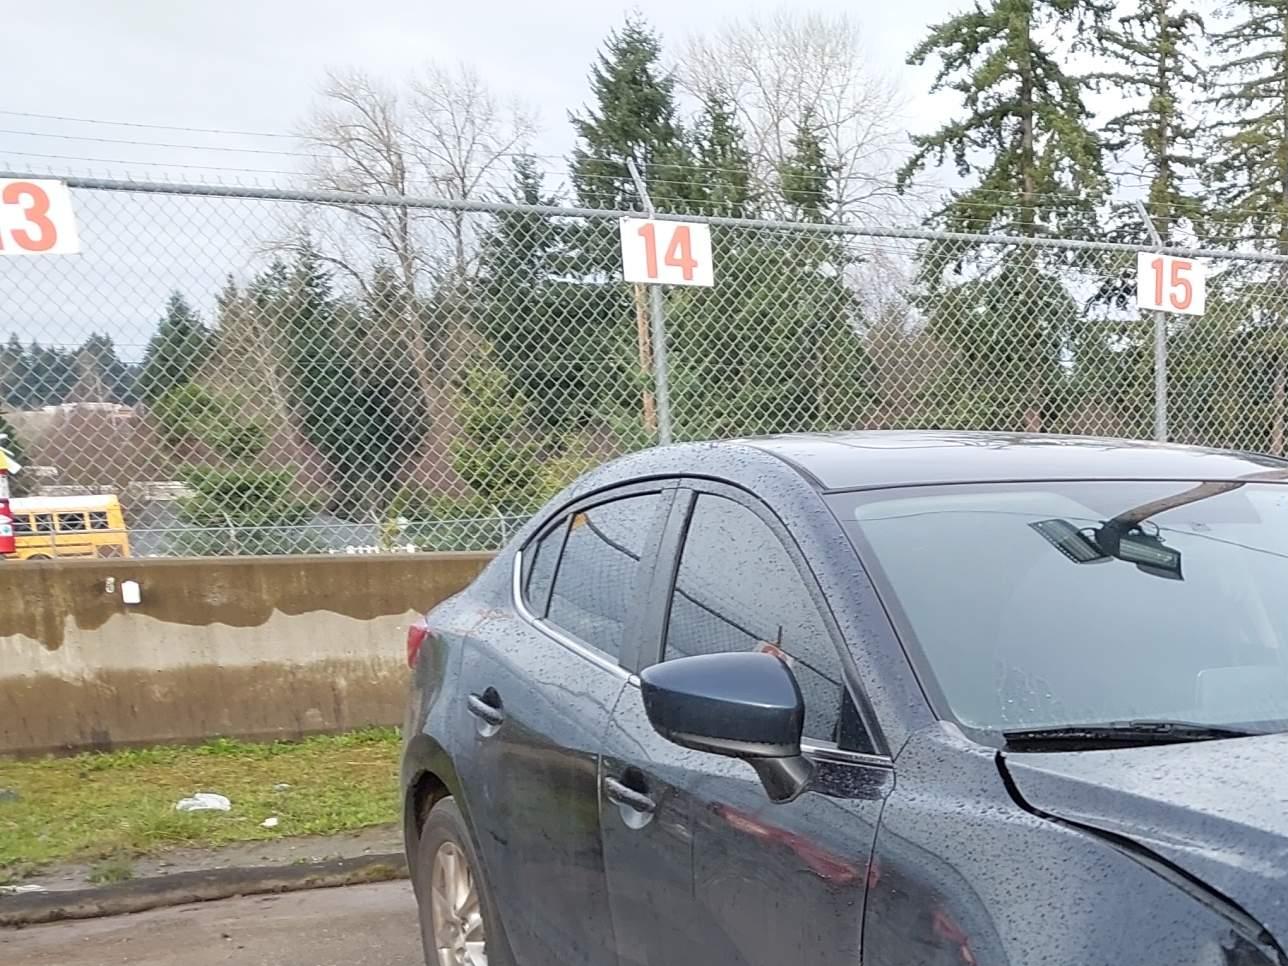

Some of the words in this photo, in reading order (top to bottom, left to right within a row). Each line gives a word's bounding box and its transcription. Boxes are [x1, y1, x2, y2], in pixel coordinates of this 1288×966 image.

[0, 182, 58, 252] 3
[637, 223, 699, 281] 14
[1152, 258, 1193, 310] 15
